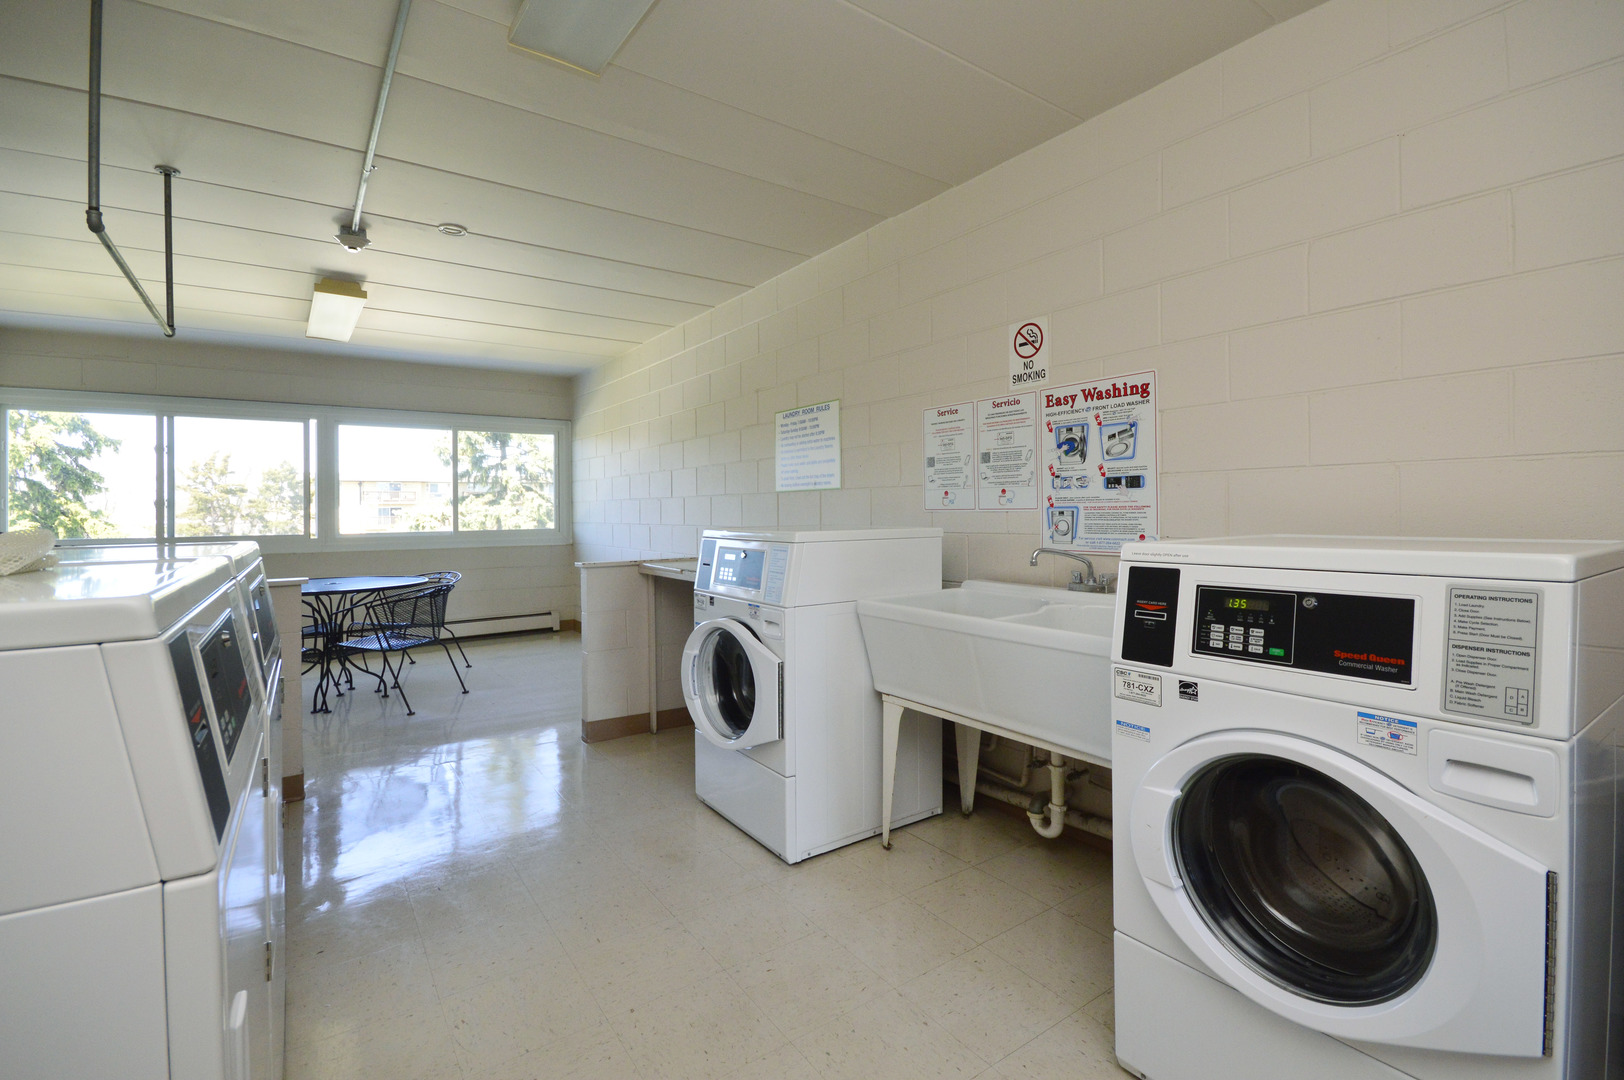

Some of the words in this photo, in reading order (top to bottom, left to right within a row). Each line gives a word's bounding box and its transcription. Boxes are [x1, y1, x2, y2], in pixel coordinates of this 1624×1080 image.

[1023, 360, 1034, 370] NO
[1012, 369, 1046, 384] SMOKING
[1045, 394, 1078, 408] Easy
[1081, 382, 1150, 402] Washing
[992, 398, 1021, 408] Servicio
[782, 410, 800, 420] LAUNDRY
[802, 407, 814, 415] ROOM
[816, 404, 830, 412] RULES
[937, 408, 958, 417] Service
[1046, 408, 1085, 418] HIGH-EFFICIENCY
[1452, 644, 1485, 652] DISPENSER
[1486, 647, 1531, 657] INSTRUCTIONS
[1334, 650, 1368, 660] Speed
[1369, 654, 1406, 665] Queen
[1338, 660, 1374, 670] Commercial
[1375, 664, 1398, 674] Washer
[1122, 680, 1154, 694] 781-CXZ
[1374, 714, 1399, 724] NOTICE
[1121, 722, 1146, 732] NOTICE
